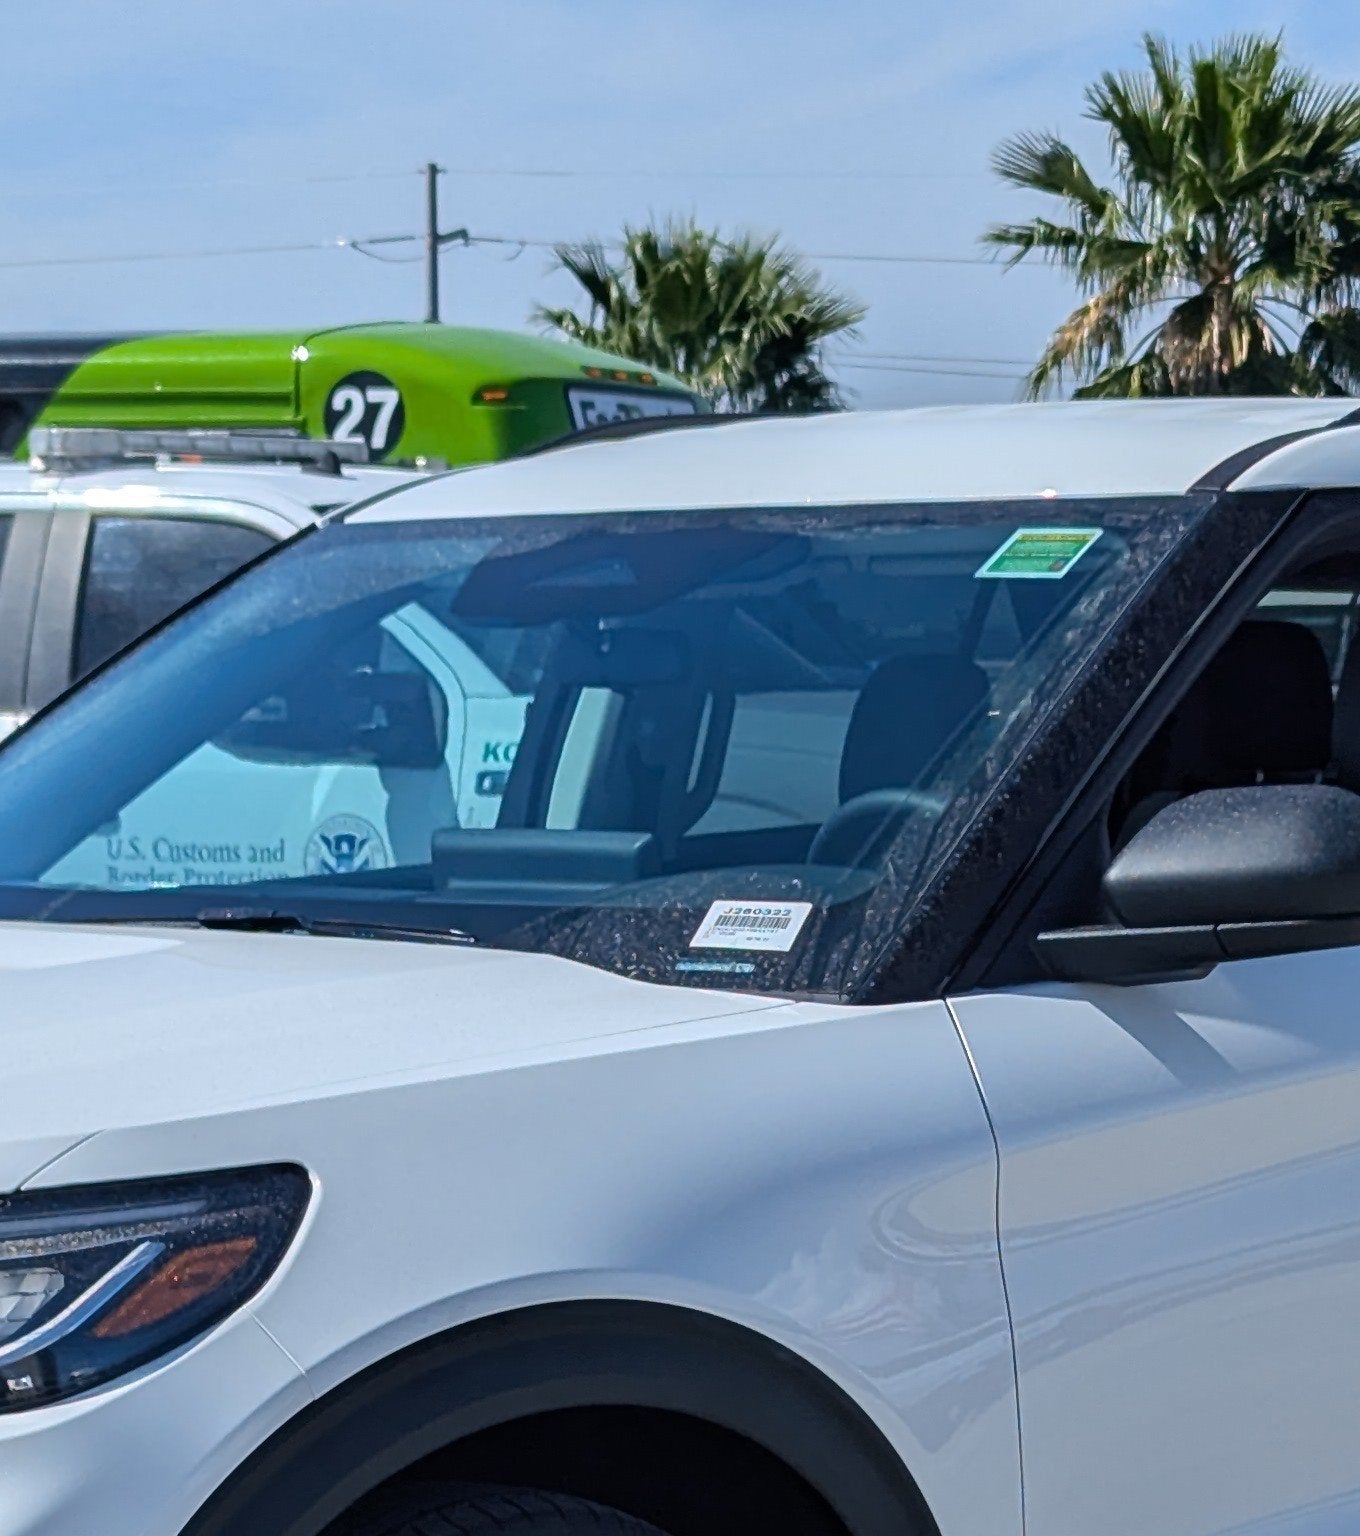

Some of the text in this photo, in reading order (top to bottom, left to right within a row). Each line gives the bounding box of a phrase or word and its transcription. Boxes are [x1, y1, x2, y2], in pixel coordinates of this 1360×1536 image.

[331, 386, 399, 449] 27
[107, 836, 286, 863] U.S. Customs and
